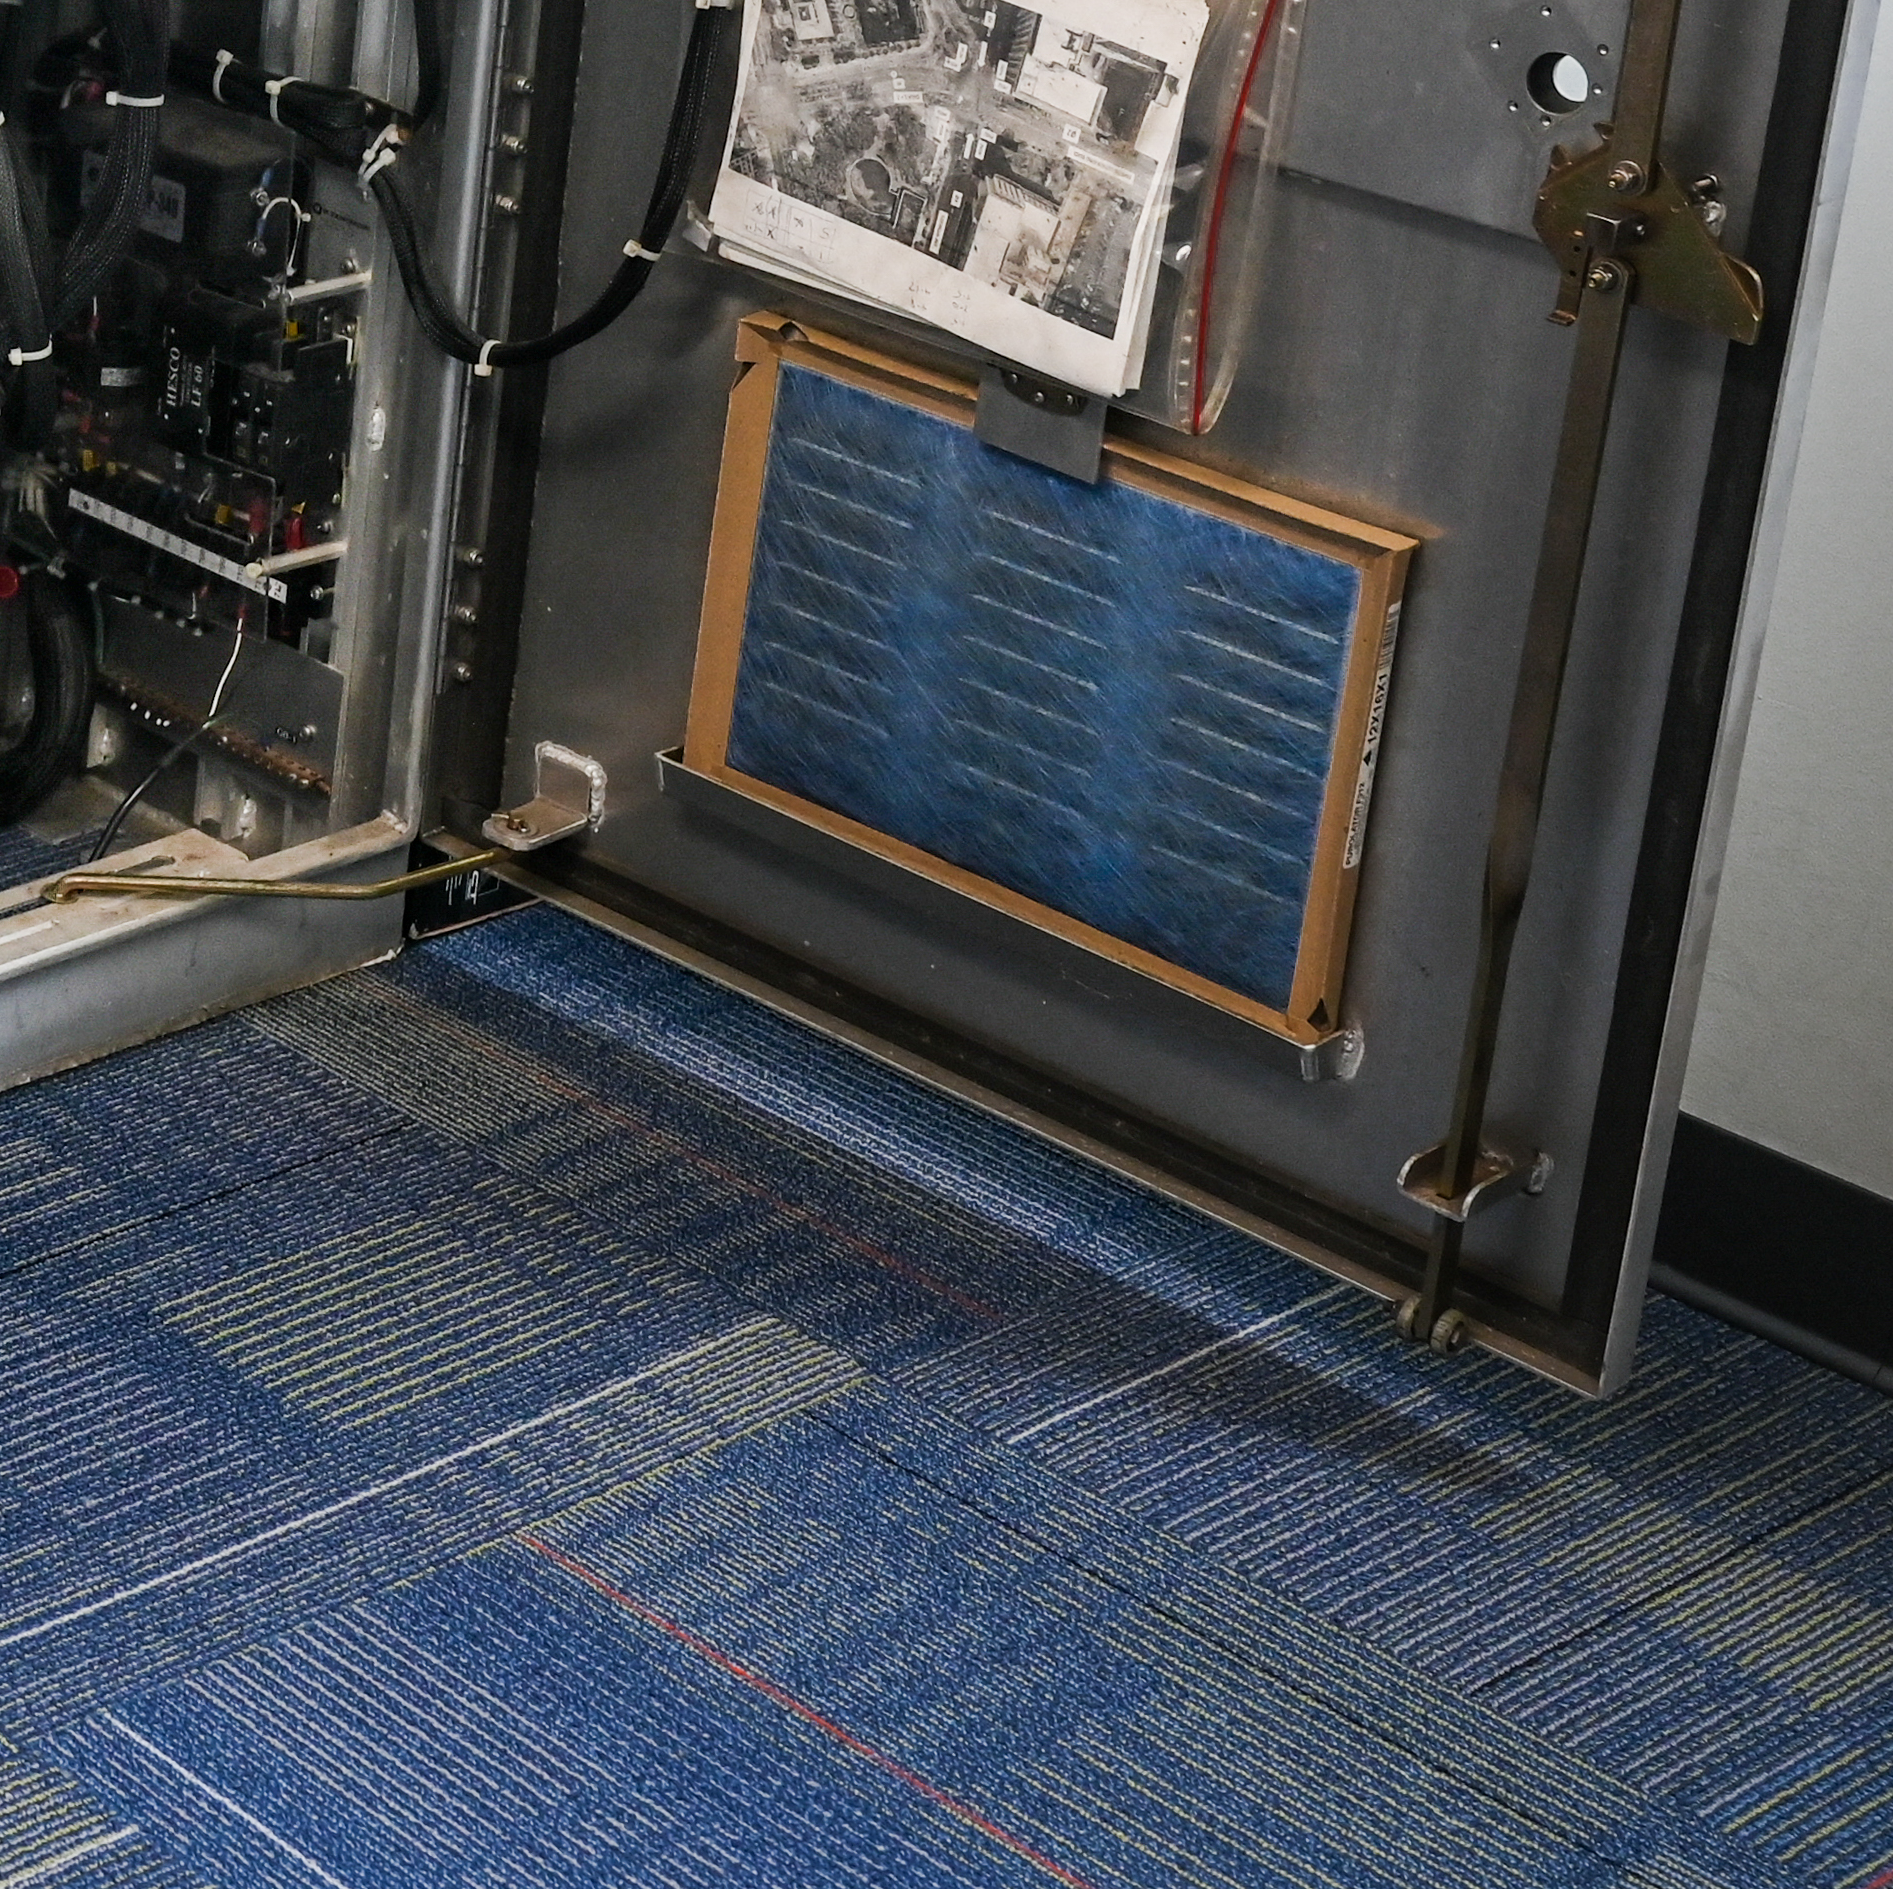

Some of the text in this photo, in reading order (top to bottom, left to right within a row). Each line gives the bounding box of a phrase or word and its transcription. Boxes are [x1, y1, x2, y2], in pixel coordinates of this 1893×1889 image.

[166, 346, 181, 408] HESCO
[190, 364, 204, 408] LF 60
[1367, 673, 1388, 745] 12X16X1
